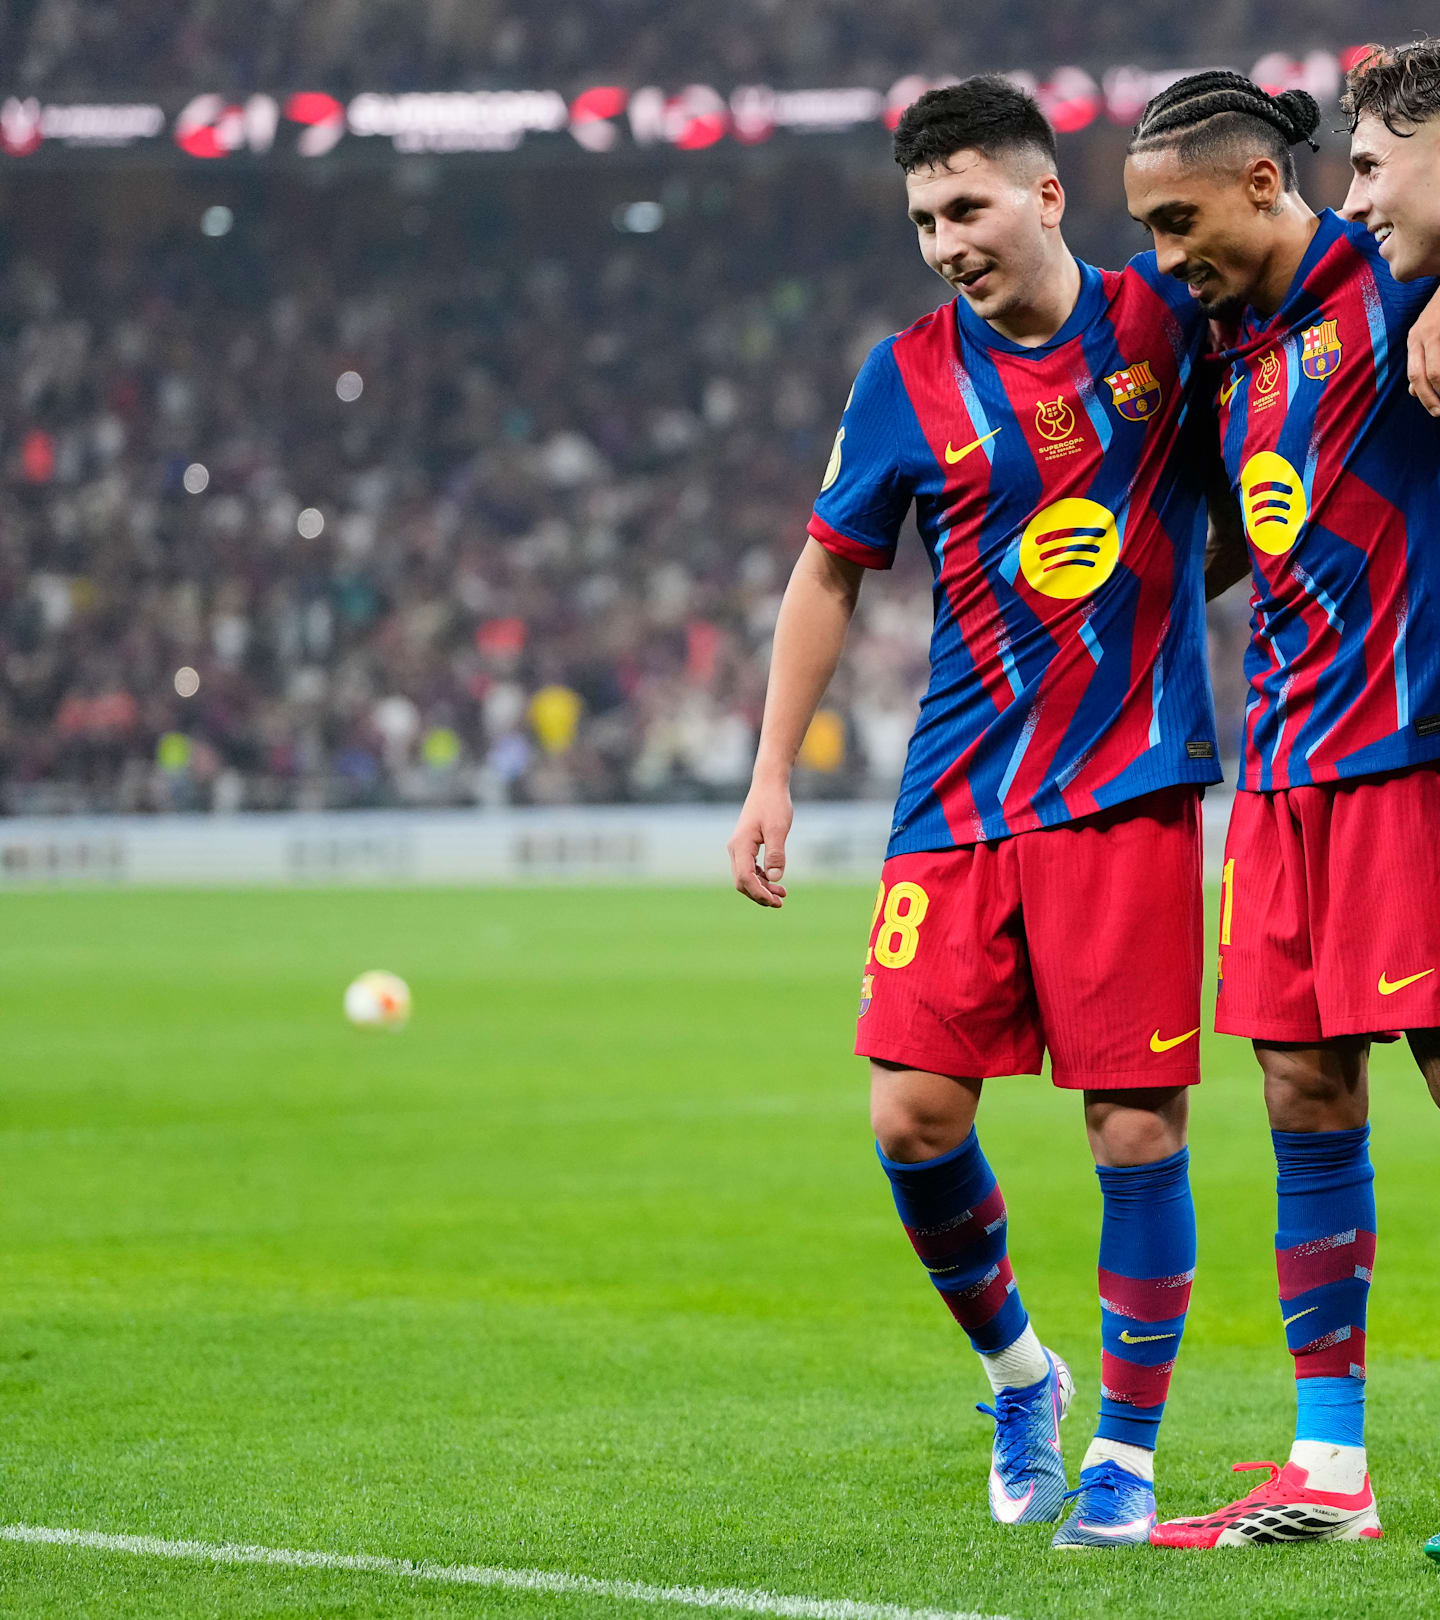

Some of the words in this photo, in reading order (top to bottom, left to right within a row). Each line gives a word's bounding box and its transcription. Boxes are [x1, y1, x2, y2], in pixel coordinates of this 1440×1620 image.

[1312, 345, 1328, 356] FCB
[1127, 385, 1145, 399] FCB
[1038, 437, 1085, 453] SUPERCOPA
[1312, 1508, 1339, 1518] TRABALHO
